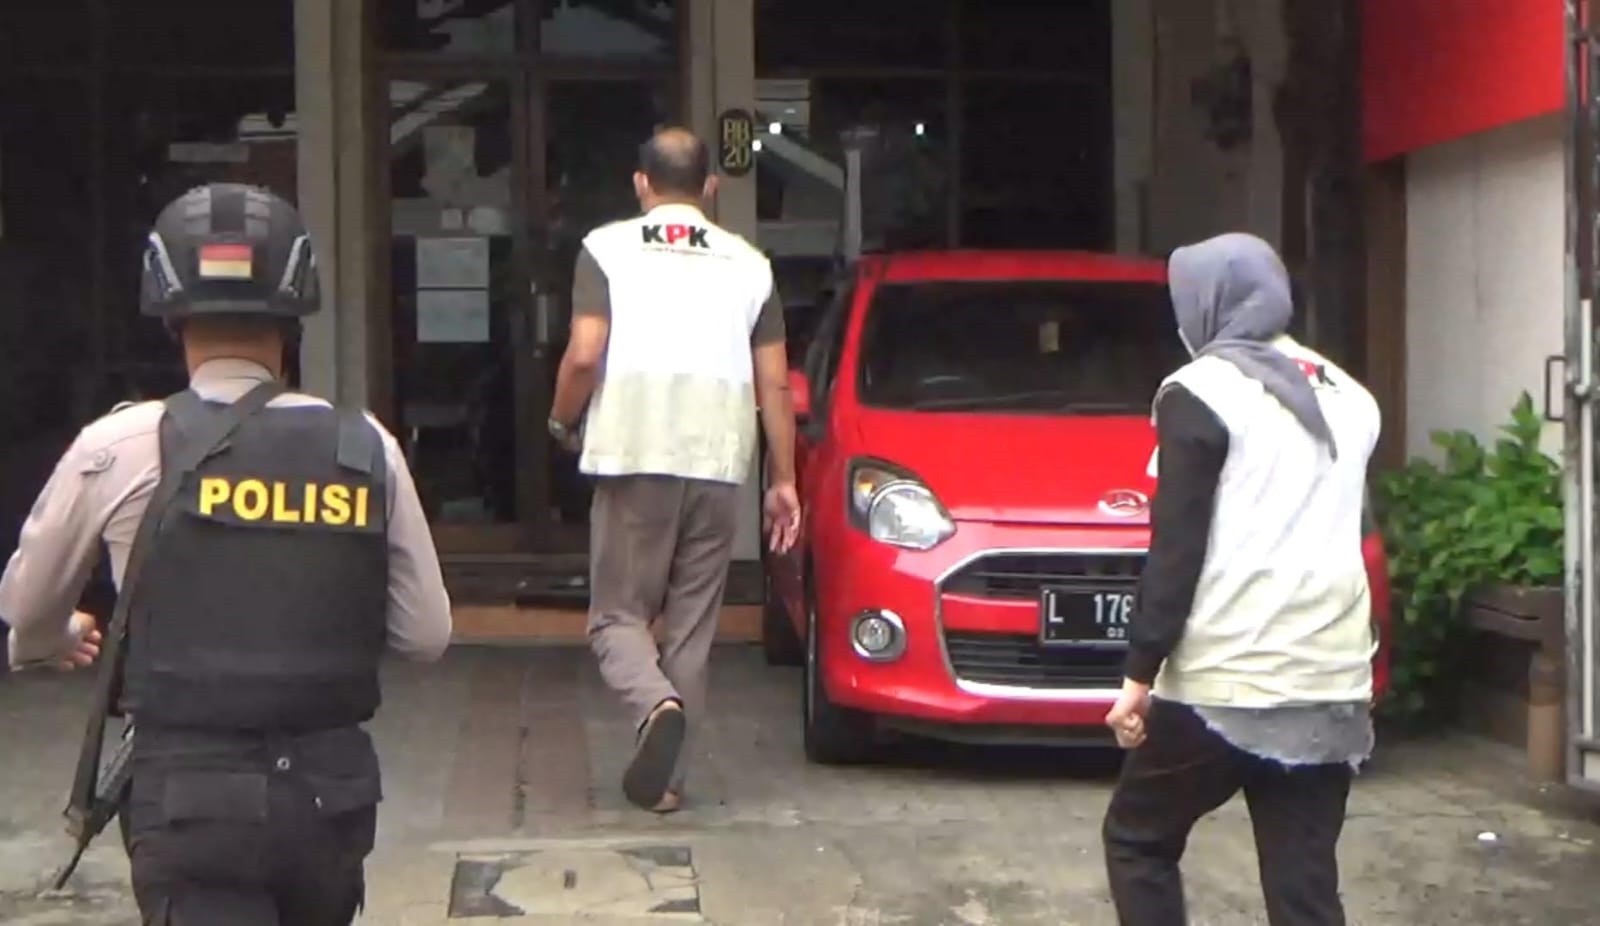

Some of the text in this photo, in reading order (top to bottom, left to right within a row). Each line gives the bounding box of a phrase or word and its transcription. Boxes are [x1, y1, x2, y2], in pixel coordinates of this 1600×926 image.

[723, 143, 750, 168] 20
[641, 223, 711, 249] KPK
[199, 476, 369, 527] POLISI
[1049, 592, 1064, 623] L
